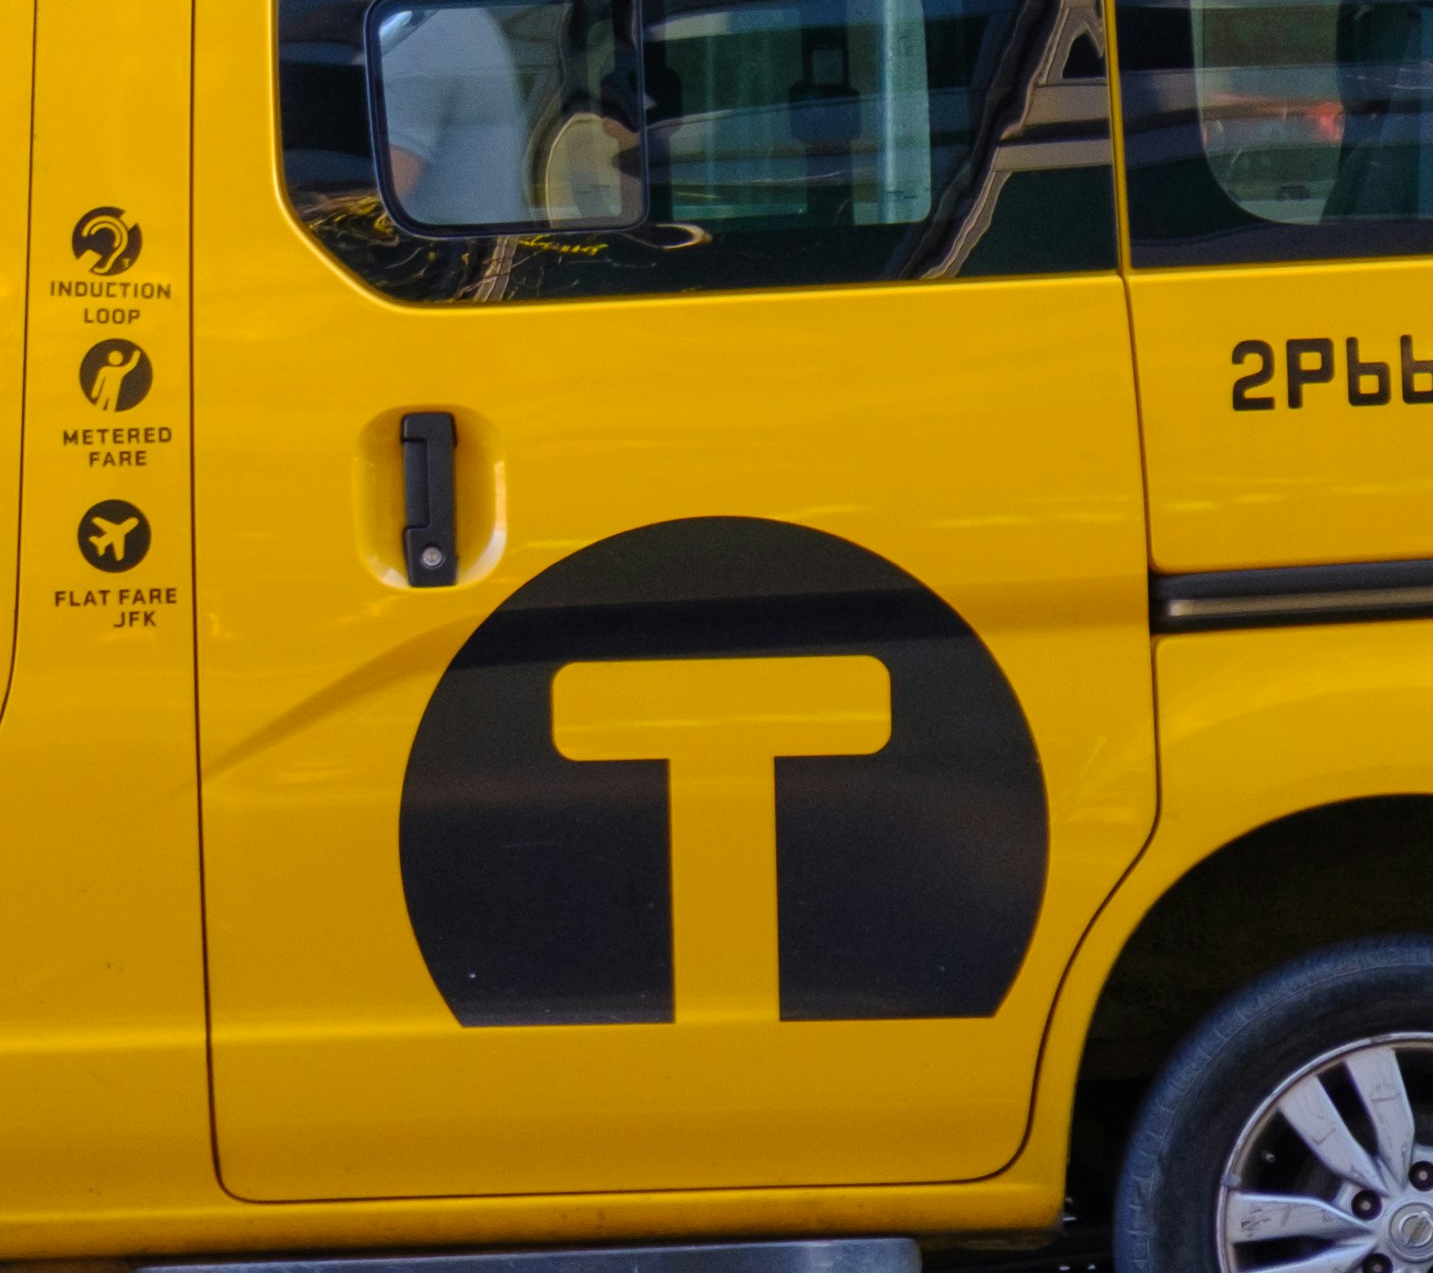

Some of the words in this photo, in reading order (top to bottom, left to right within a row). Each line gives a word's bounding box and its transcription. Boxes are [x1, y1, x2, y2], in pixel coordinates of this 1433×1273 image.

[49, 280, 172, 300] INDUCTION
[83, 307, 141, 325] LOOP
[63, 427, 172, 446] METERED
[89, 450, 147, 467] FARE
[54, 590, 112, 607] FLAT
[118, 588, 178, 606] FARE
[113, 611, 157, 628] JFK
